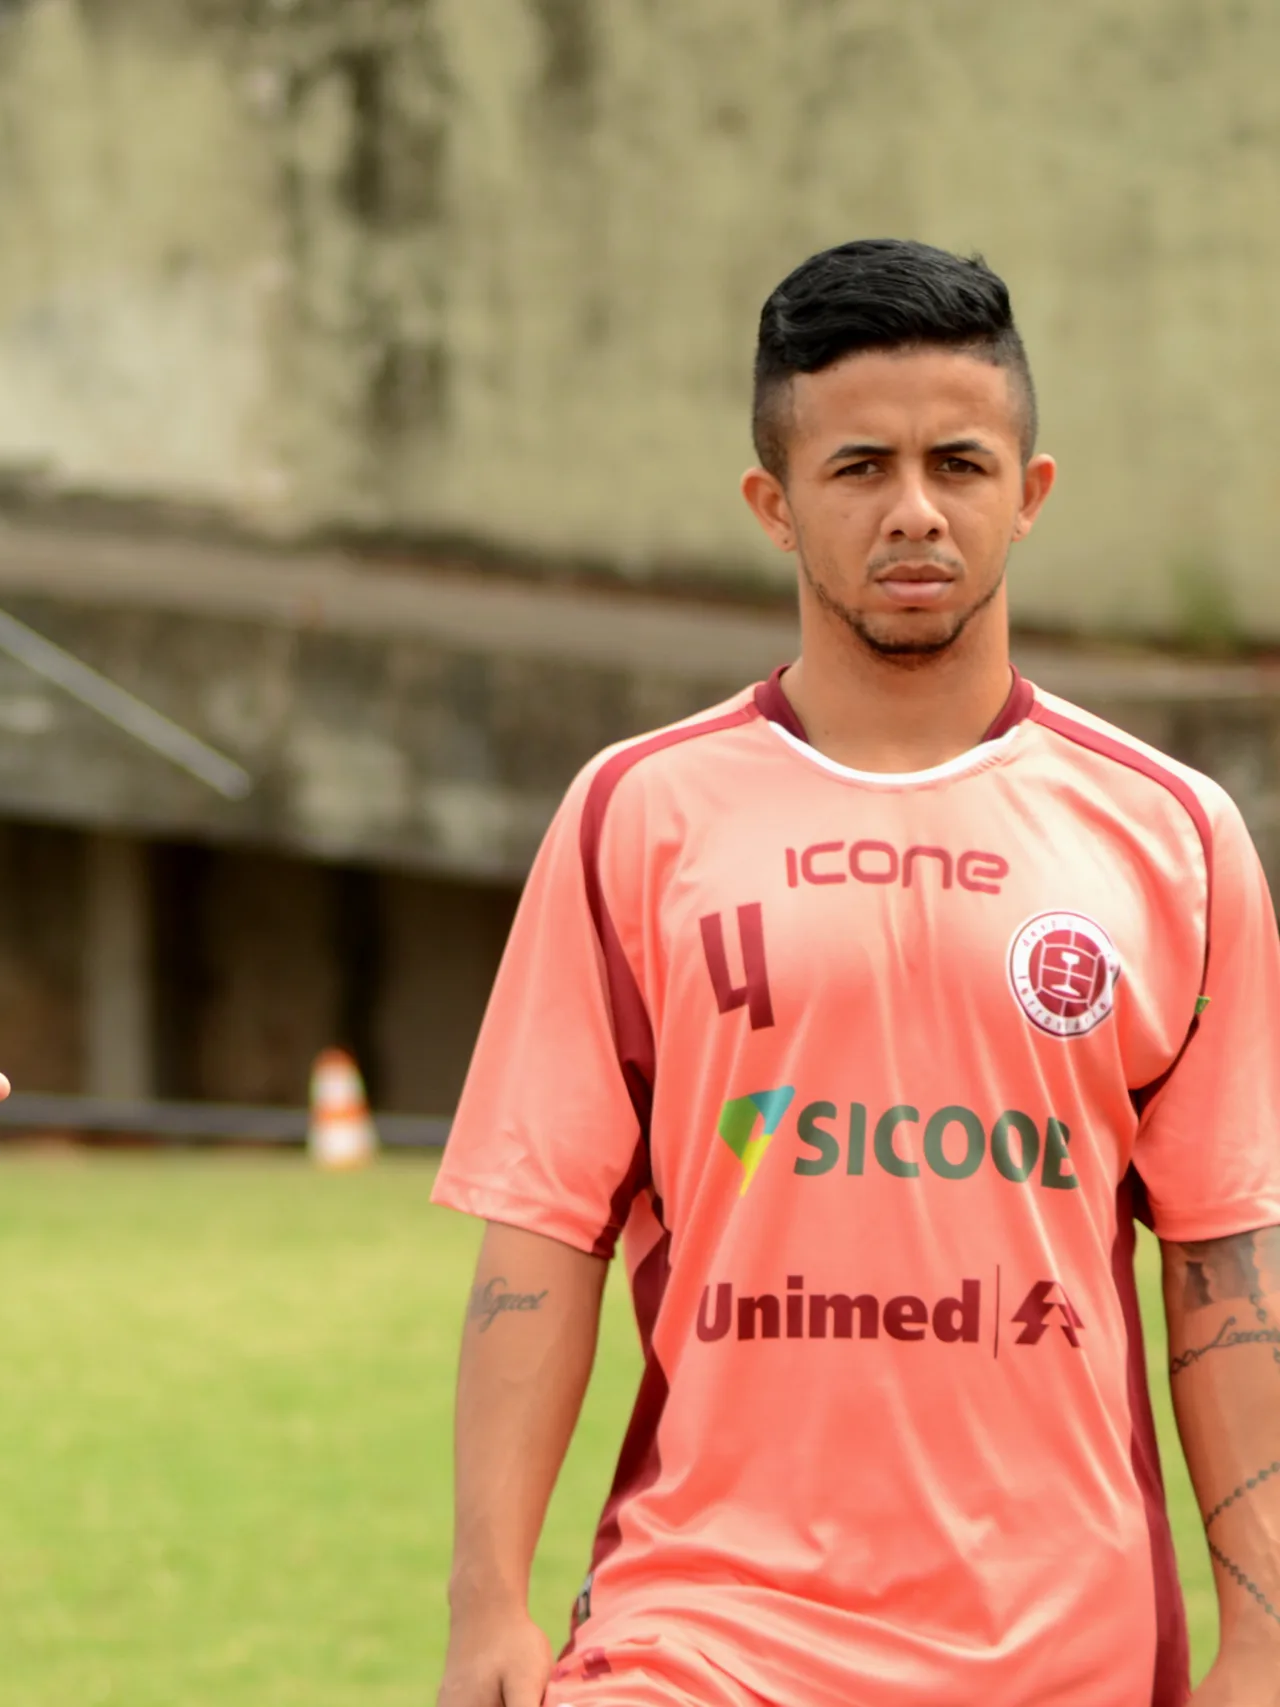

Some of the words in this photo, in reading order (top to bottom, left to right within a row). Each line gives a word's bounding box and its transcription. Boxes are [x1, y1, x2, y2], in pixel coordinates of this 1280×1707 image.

[699, 902, 776, 1031] 4
[793, 1100, 1080, 1190] SICOOB
[696, 1275, 981, 1342] Unimed
